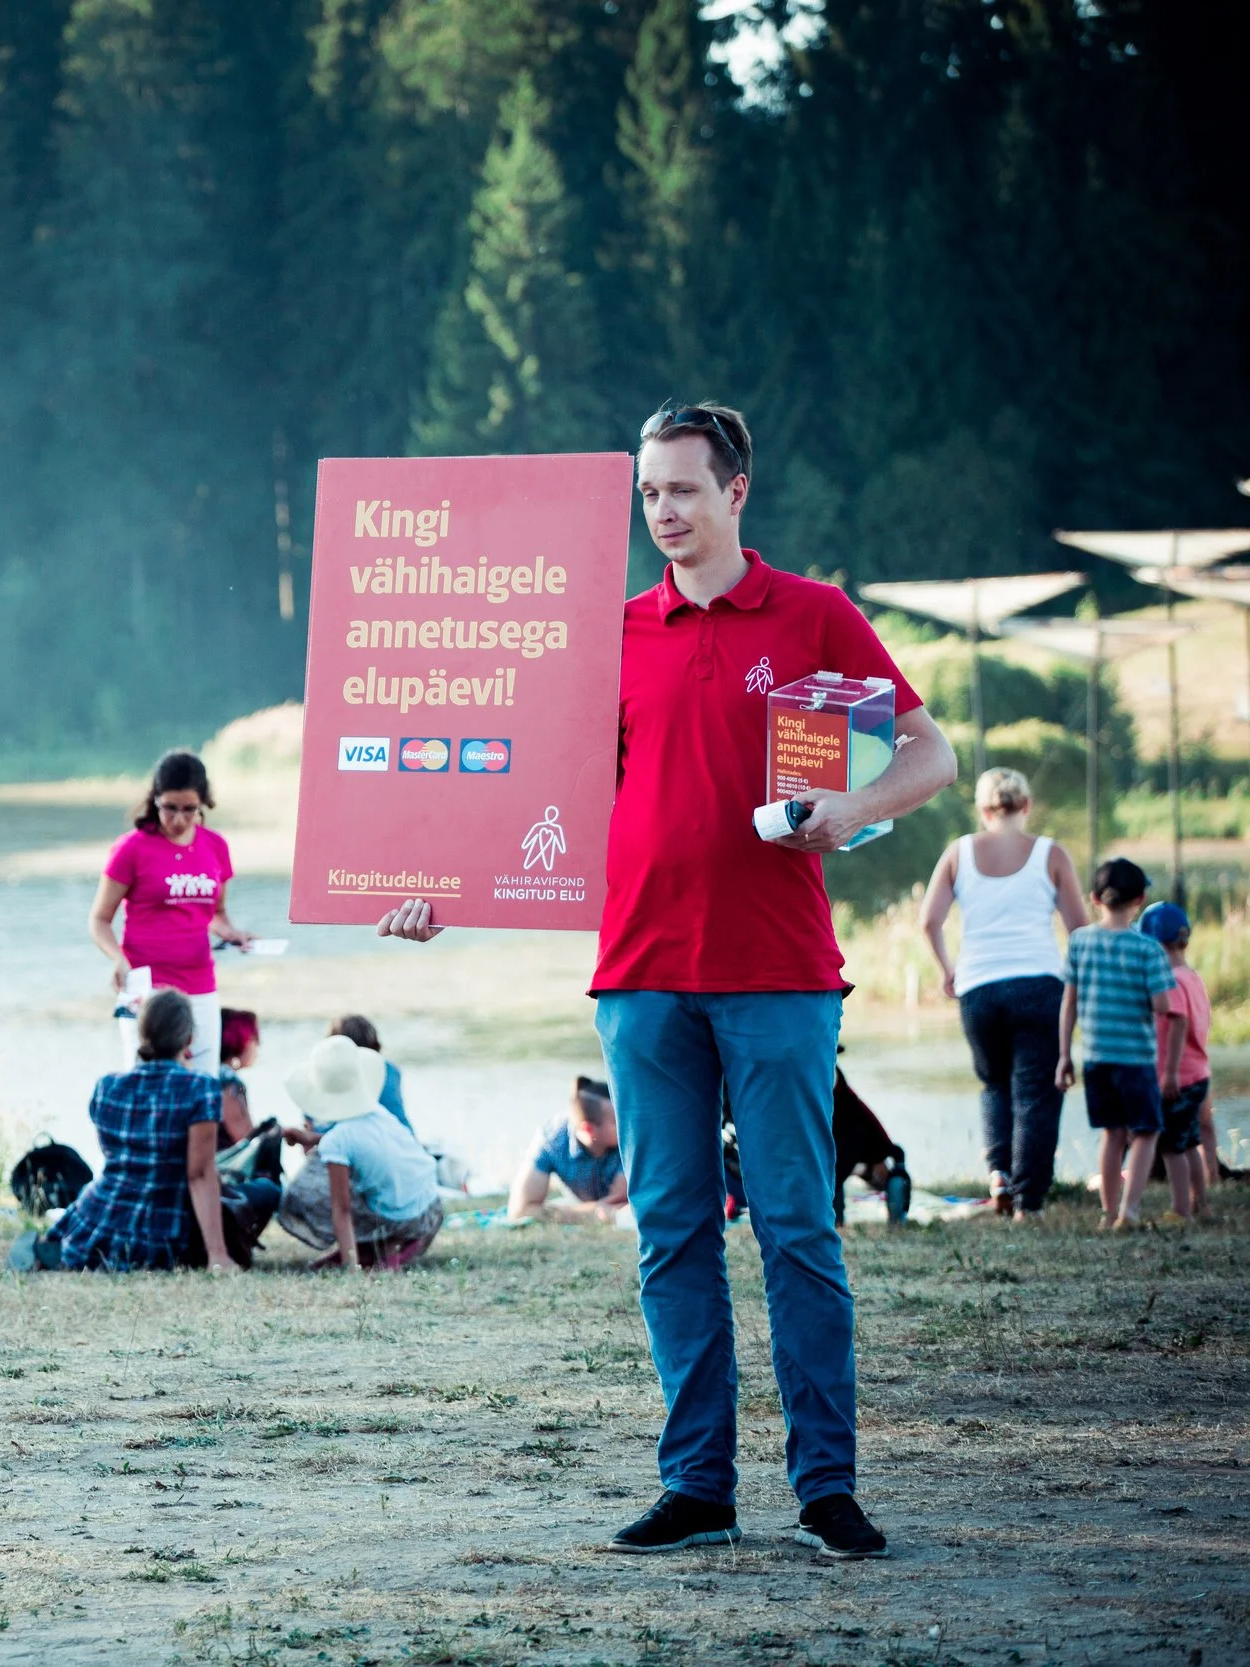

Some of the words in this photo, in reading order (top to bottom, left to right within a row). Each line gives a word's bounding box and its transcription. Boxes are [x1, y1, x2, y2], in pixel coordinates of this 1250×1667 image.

[354, 500, 450, 547] Kingi
[349, 556, 568, 604] vähihaigele
[346, 617, 568, 659] annetusega
[342, 666, 516, 714] elupäevi!
[777, 715, 806, 731] Kingi
[777, 728, 840, 747] vähihaigele
[345, 746, 387, 763] VISA
[402, 749, 448, 760] MasterCard
[466, 751, 504, 761] Maestro
[777, 742, 841, 761] annetusega
[777, 752, 823, 769] elupäevi
[327, 869, 462, 891] Kingitudelu.ee
[494, 873, 585, 887] VÄHIRAVIFOND
[493, 888, 556, 900] KINGITUD
[559, 890, 585, 901] ELU
